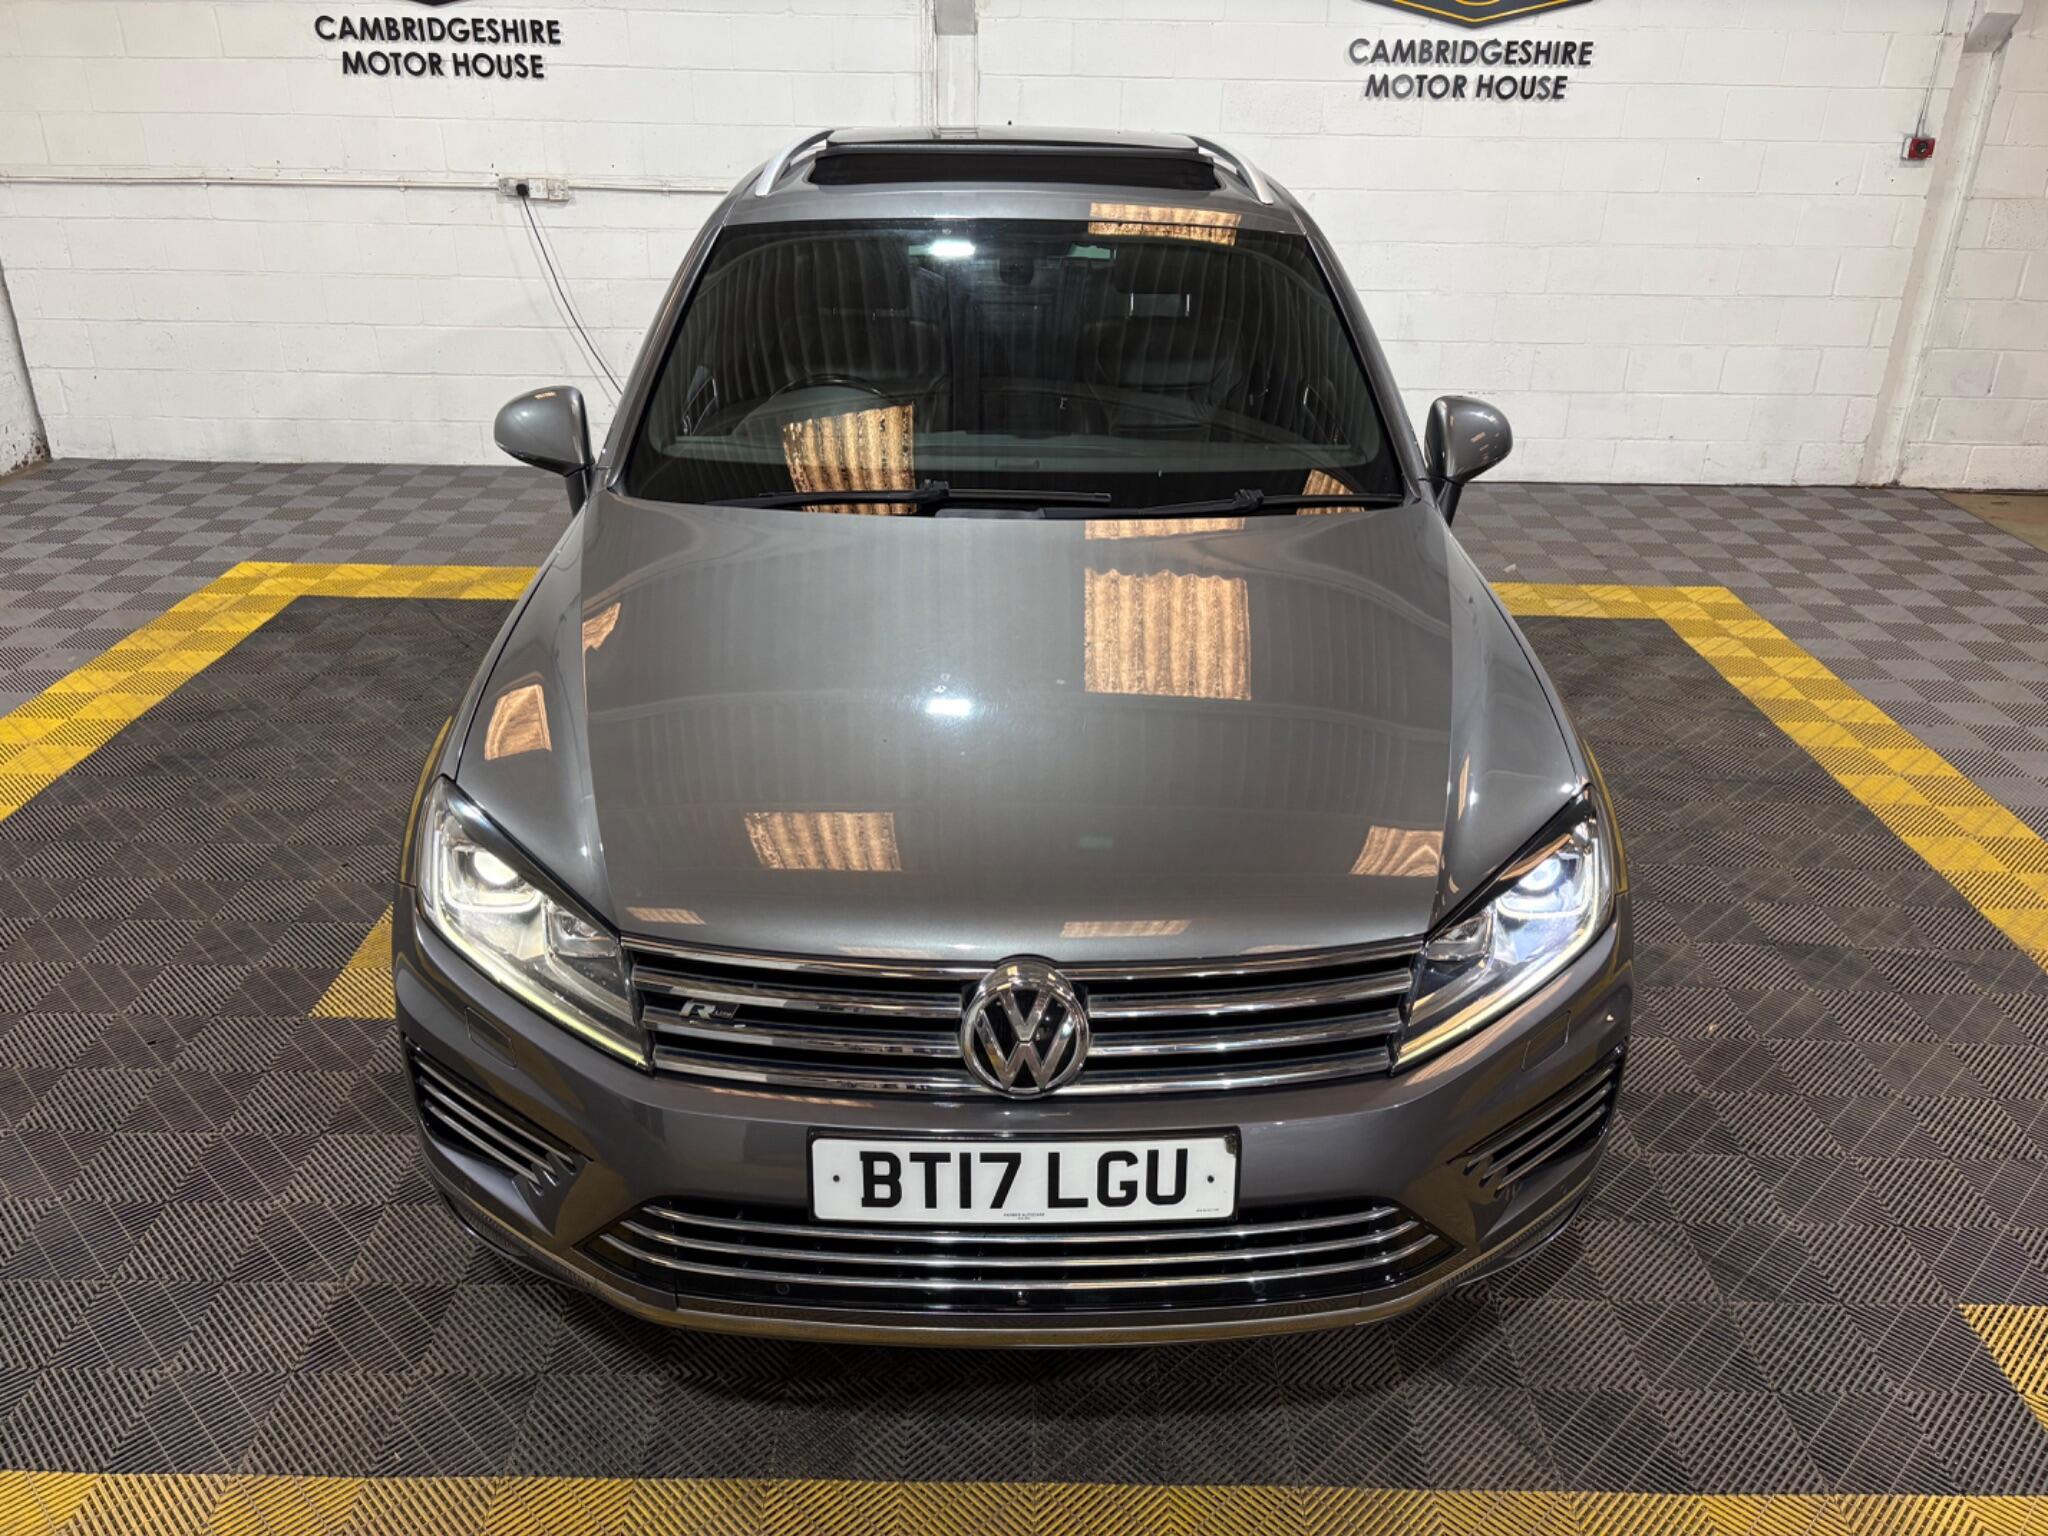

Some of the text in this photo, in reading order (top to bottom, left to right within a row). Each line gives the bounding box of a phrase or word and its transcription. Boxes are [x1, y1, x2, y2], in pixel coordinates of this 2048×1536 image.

[314, 15, 562, 46] CAMBRIDGESHIRE
[341, 50, 545, 79] MOTOR HOUSE
[1348, 37, 1594, 66] CAMBRIDGESHIRE
[1364, 73, 1569, 100] MOTOR HOUSE
[859, 1147, 1189, 1210] BT17 LGU
